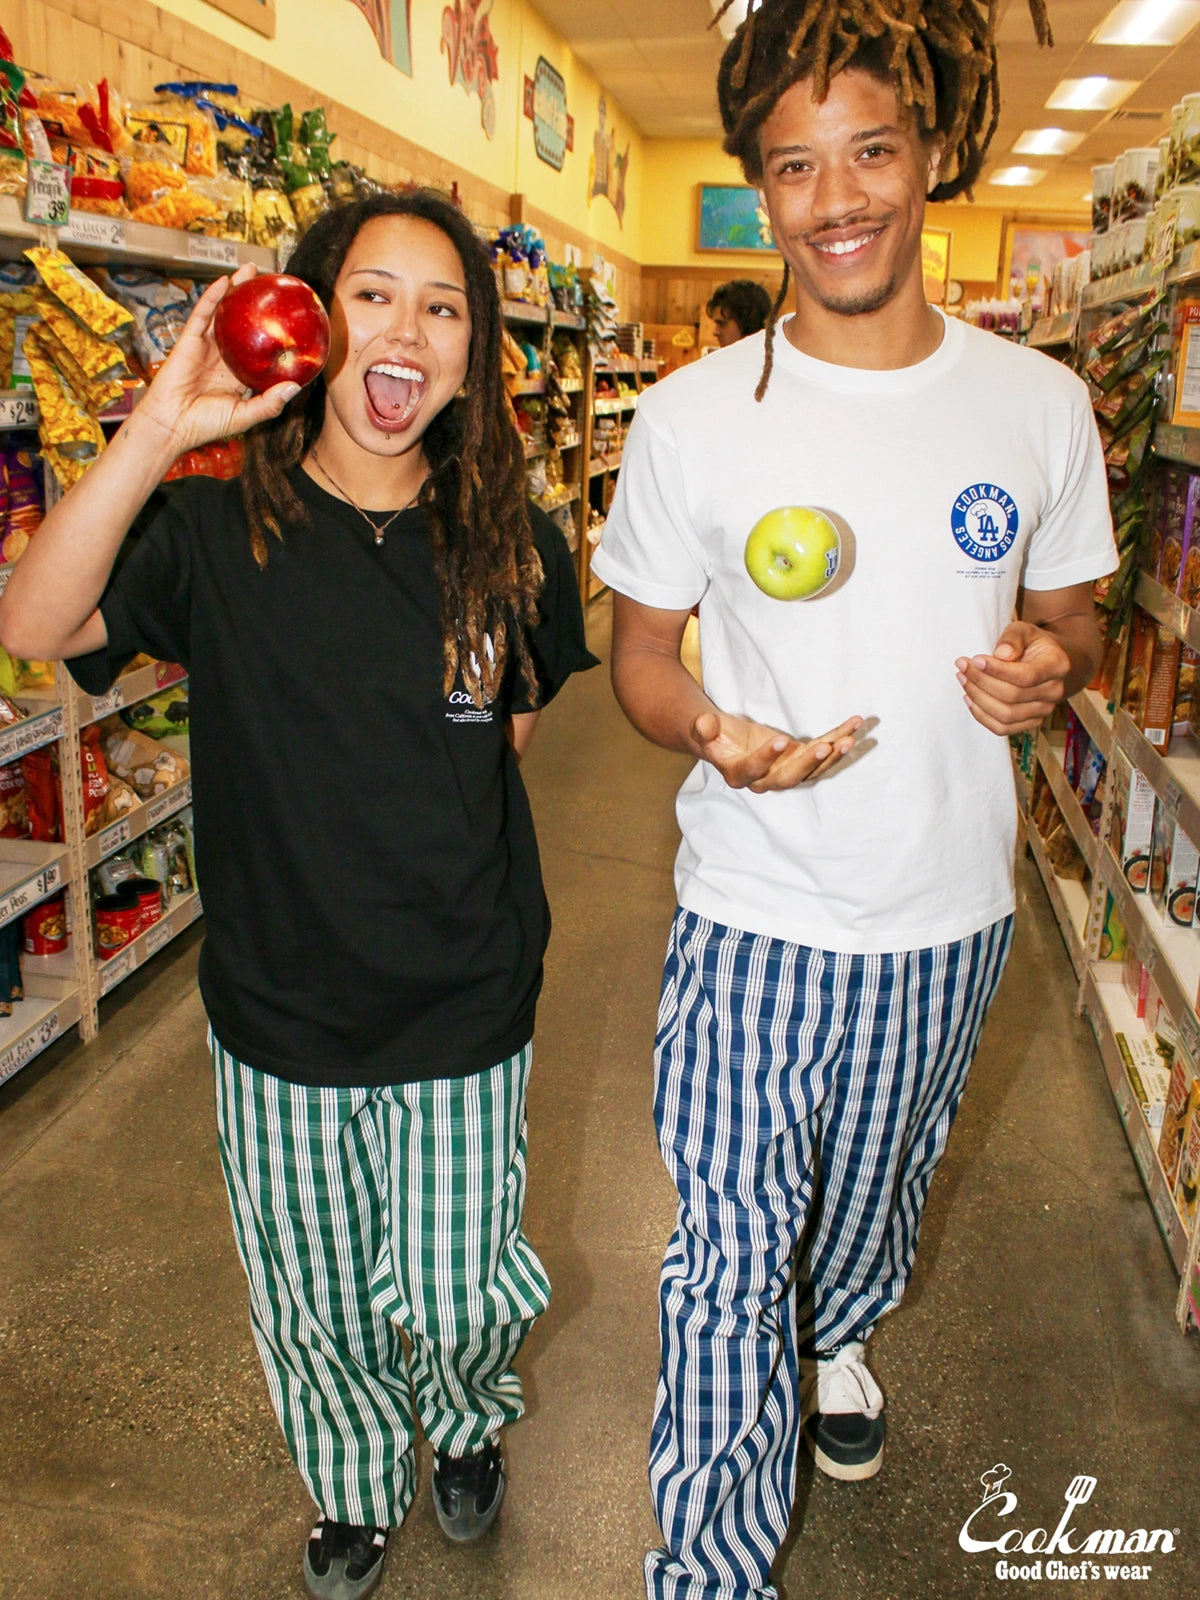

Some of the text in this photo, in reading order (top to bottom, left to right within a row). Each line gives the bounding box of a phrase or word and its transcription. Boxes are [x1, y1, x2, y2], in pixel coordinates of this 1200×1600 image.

[954, 485, 1016, 514] COOKMAN
[977, 514, 999, 542] LA
[1000, 529, 1015, 552] LOS
[954, 526, 998, 559] ANGELES
